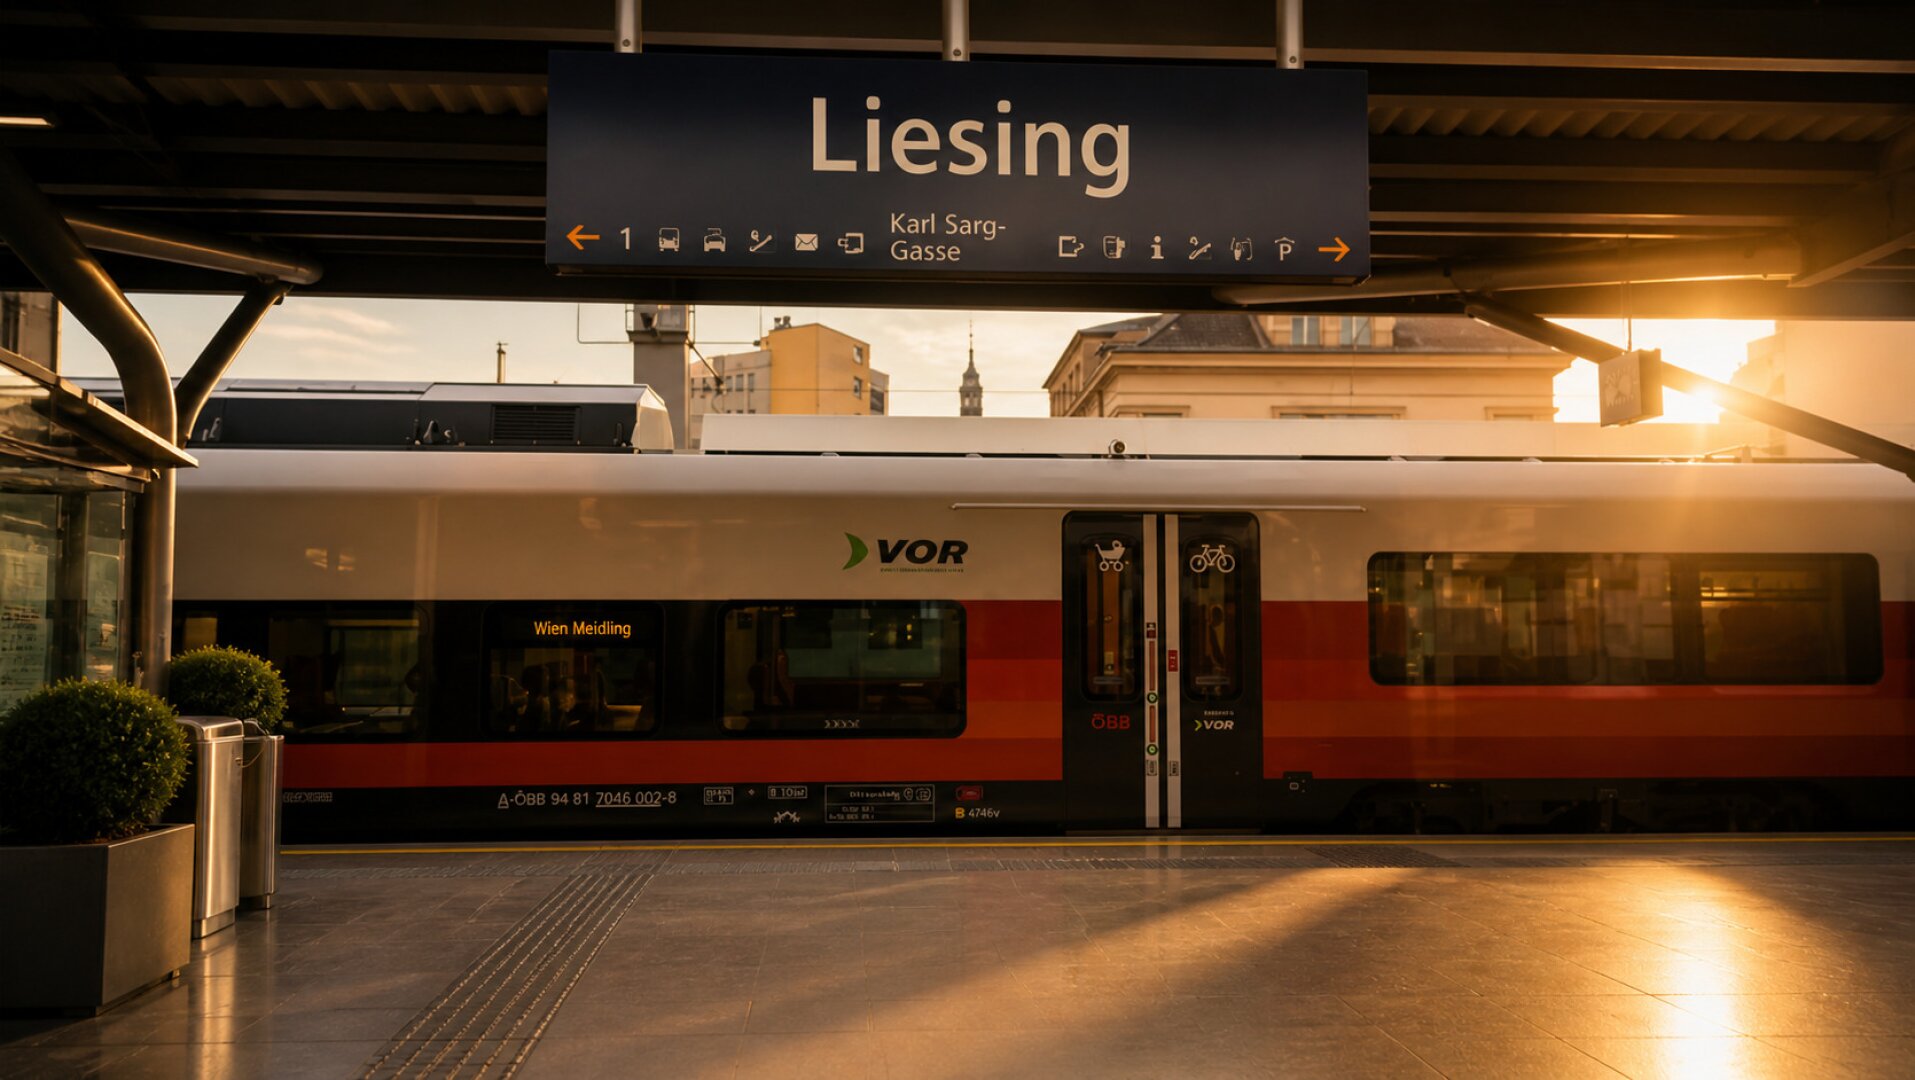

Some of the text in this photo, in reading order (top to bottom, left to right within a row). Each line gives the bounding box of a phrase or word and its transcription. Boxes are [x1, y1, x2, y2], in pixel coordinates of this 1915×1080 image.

[812, 95, 1130, 198] Liesing
[891, 213, 1006, 239] Karl Sarg-
[620, 228, 630, 249] 1
[891, 239, 960, 262] Gasse
[877, 539, 969, 565] VOR
[533, 620, 632, 639] Wien Meidling
[1091, 714, 1131, 730] ÖBB
[1202, 720, 1235, 730] VOR
[551, 792, 569, 806] 94
[573, 792, 589, 806] 81
[595, 791, 631, 807] 7046
[635, 790, 677, 806] 002-8
[968, 807, 1000, 819] 4746v
